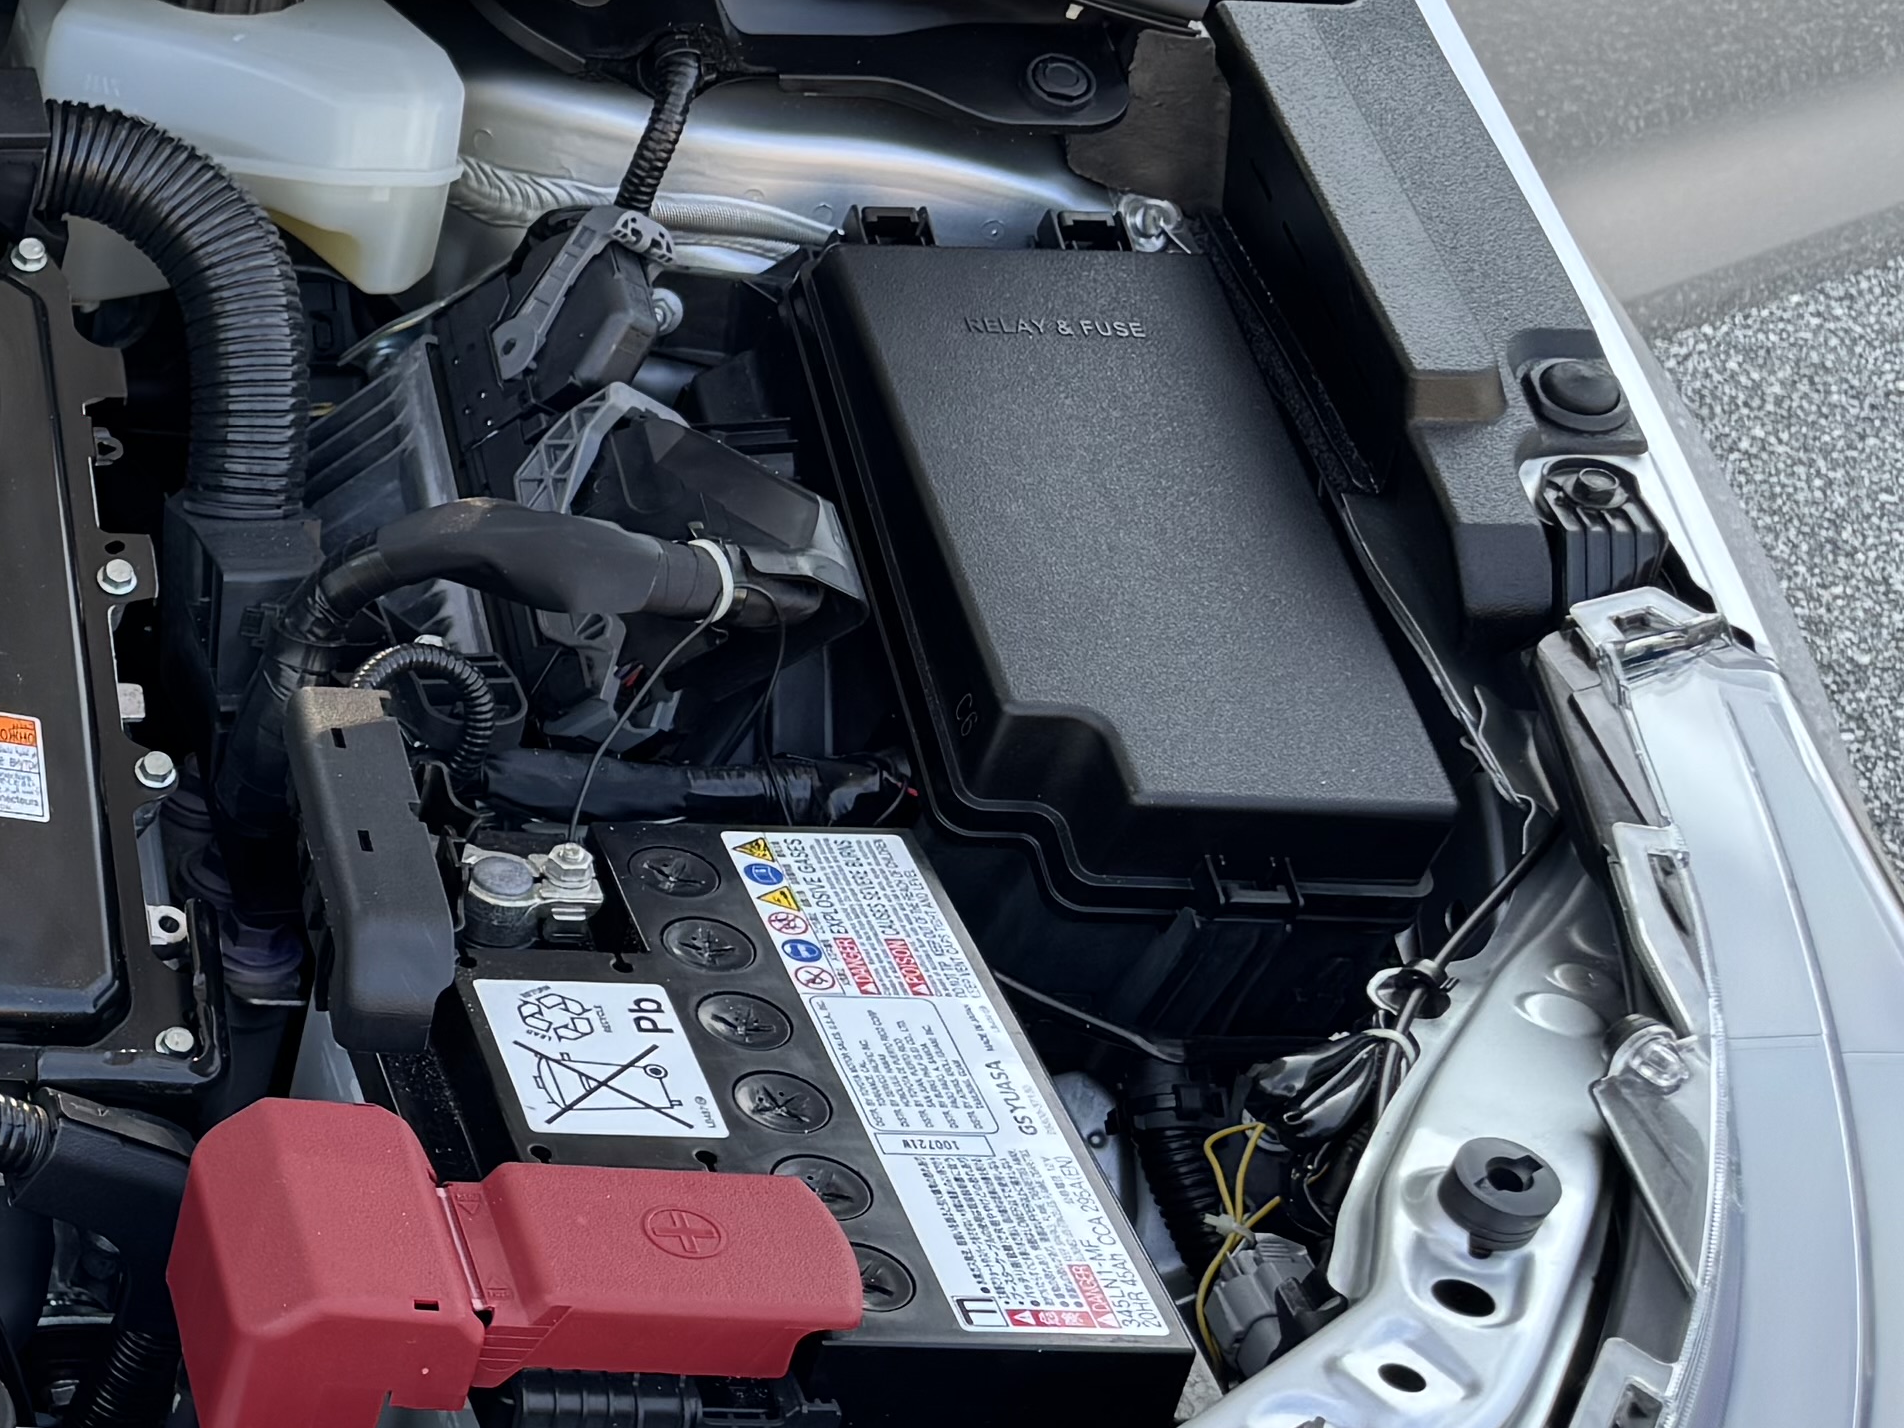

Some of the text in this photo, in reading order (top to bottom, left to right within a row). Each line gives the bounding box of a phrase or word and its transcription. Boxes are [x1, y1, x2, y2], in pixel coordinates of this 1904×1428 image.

[965, 317, 1146, 338] RELAY & FUSE
[782, 838, 818, 872] GASES
[801, 876, 849, 933] EXPLOSIVE
[834, 938, 873, 982] DANGER
[885, 940, 925, 983] POISON
[627, 997, 674, 1034] Pb
[525, 1029, 552, 1042] LEAD
[902, 1138, 959, 1150] 100721W
[1052, 1155, 1101, 1212] 295A(EN)
[1084, 1215, 1119, 1245] CCA
[1078, 1239, 1143, 1328] 345LN1-MF
[1103, 1252, 1141, 1286] 45Ah
[1069, 1265, 1110, 1311] DANGER
[1124, 1290, 1163, 1327] 20HR
